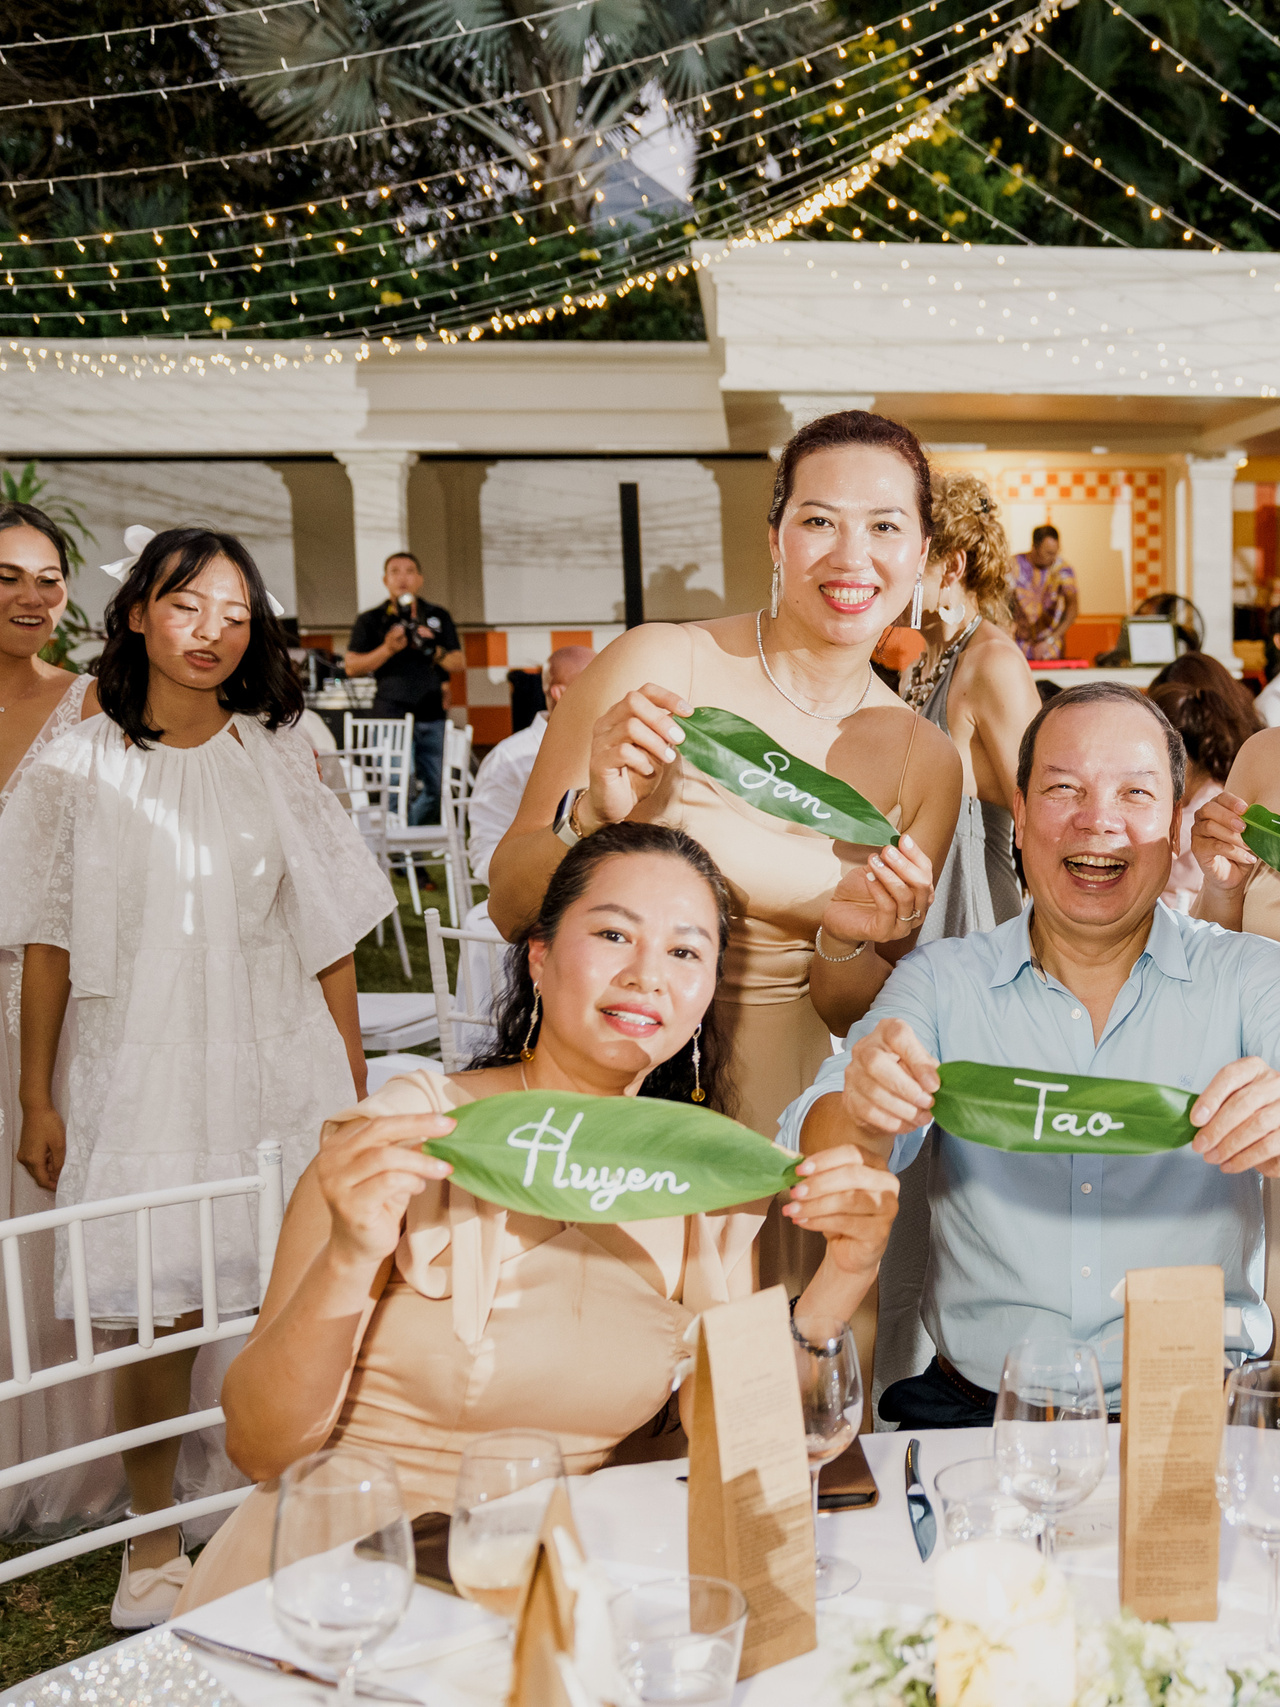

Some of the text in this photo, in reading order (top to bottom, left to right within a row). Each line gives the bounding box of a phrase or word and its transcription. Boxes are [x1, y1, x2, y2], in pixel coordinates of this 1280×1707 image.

[738, 751, 831, 819] San
[1013, 1077, 1125, 1140] Tao
[506, 1106, 691, 1212] Huyen
